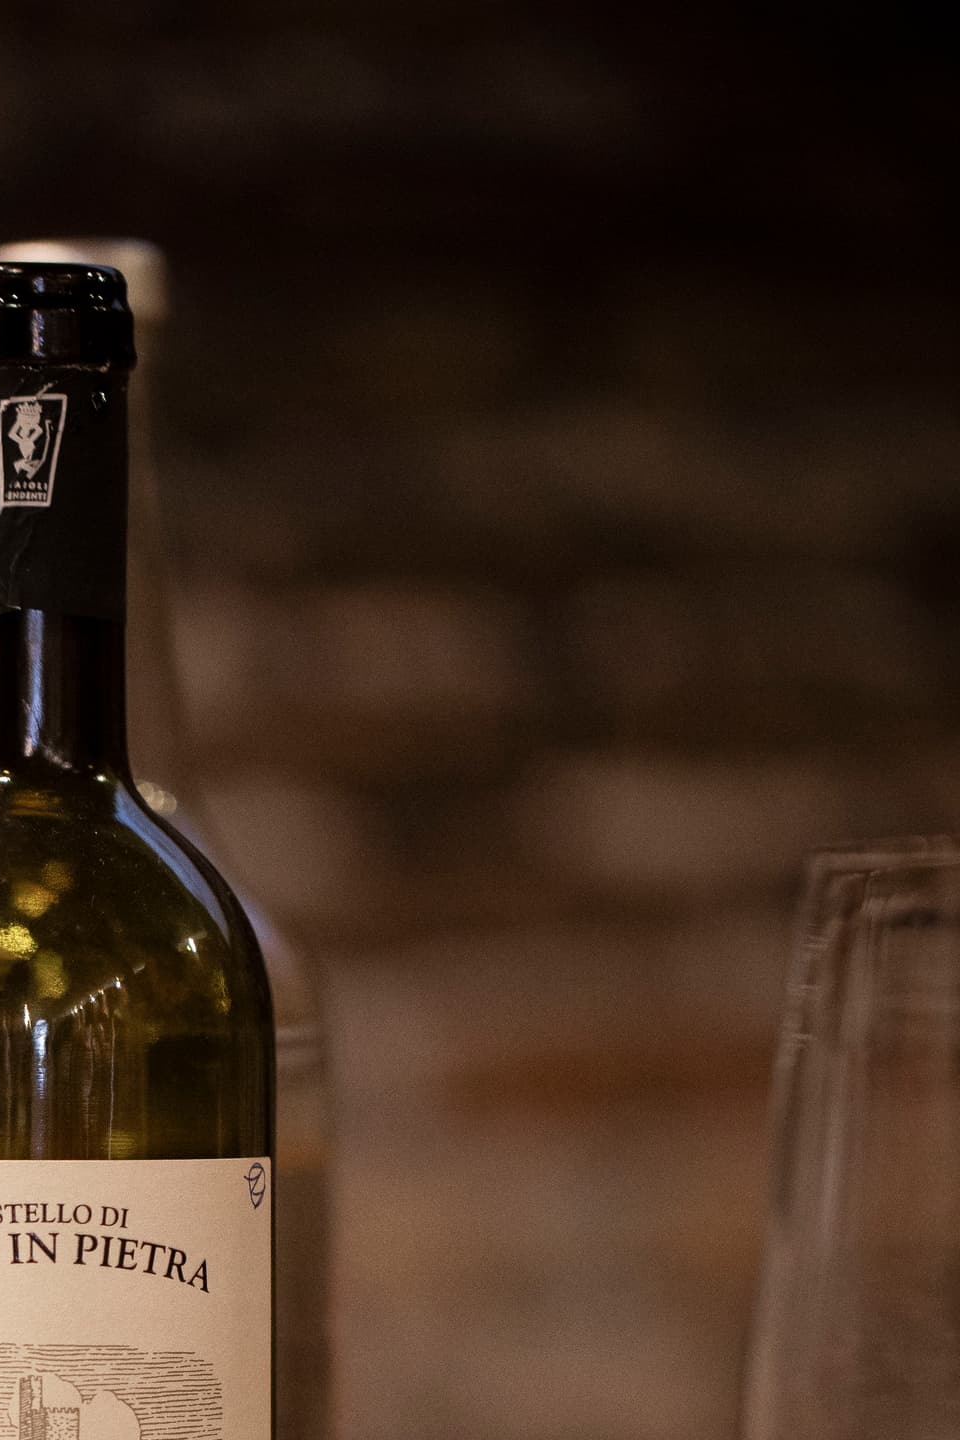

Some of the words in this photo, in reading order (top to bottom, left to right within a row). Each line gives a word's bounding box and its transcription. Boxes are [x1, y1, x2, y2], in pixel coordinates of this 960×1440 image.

[100, 1206, 129, 1229] DI
[7, 1232, 59, 1264] IN
[74, 1233, 210, 1293] PIETRA
